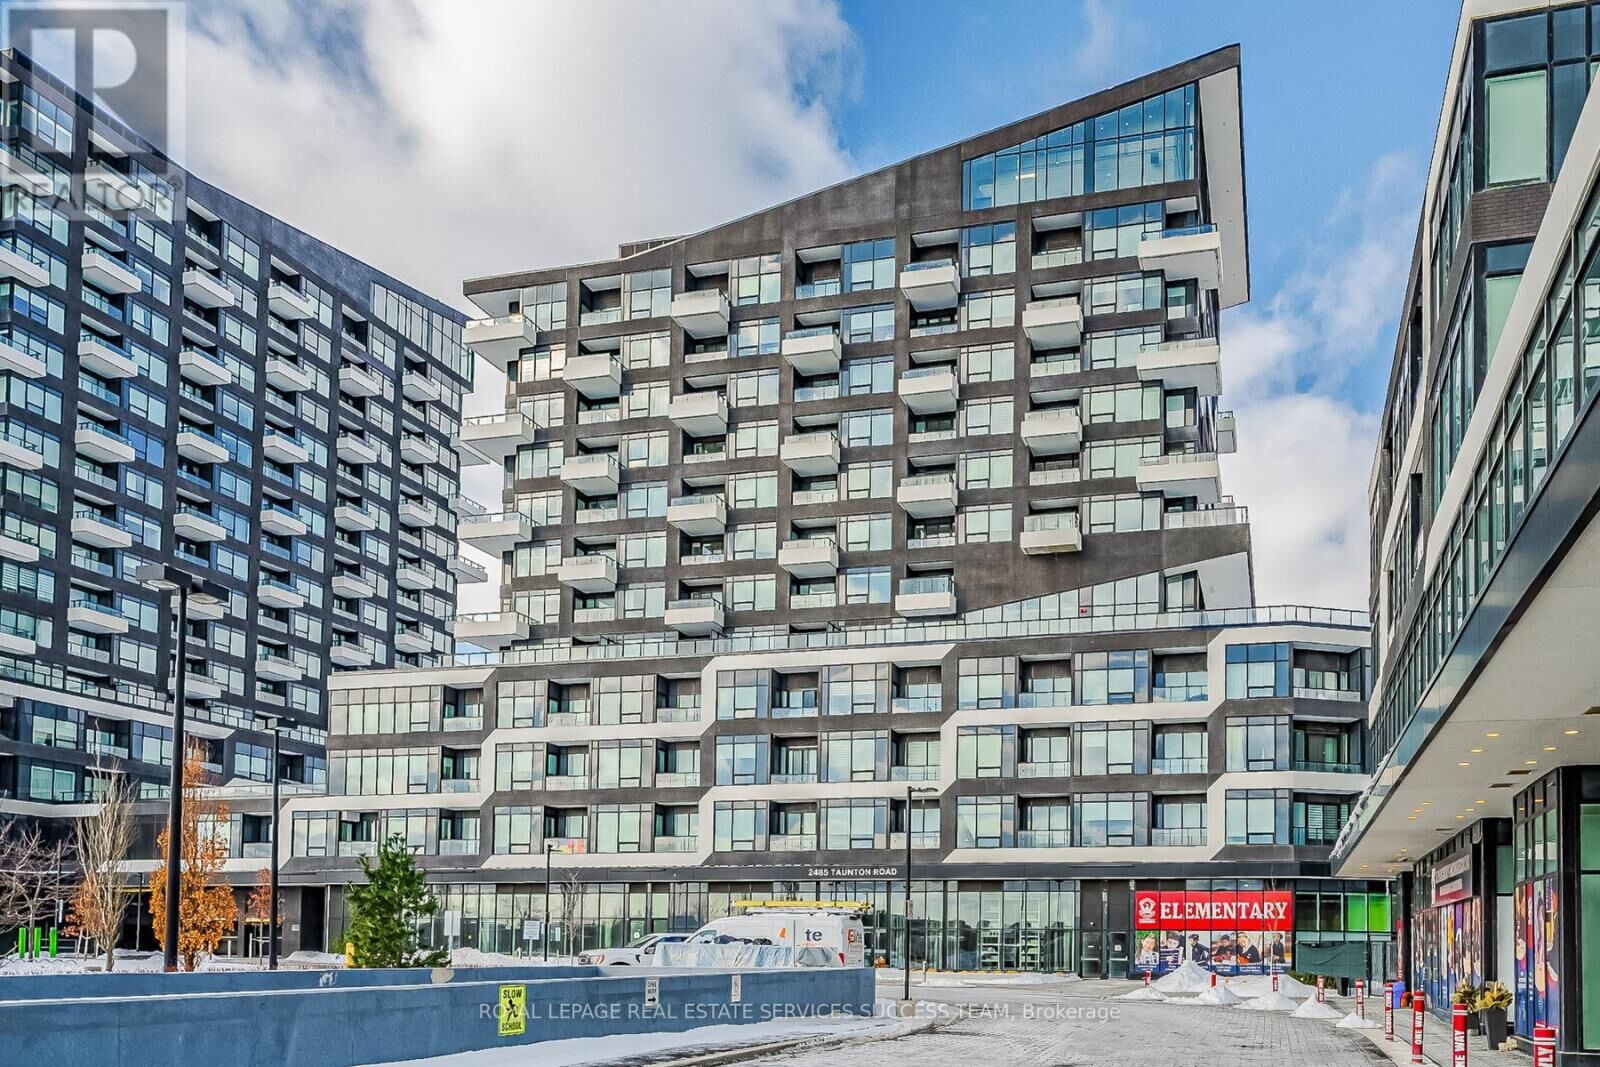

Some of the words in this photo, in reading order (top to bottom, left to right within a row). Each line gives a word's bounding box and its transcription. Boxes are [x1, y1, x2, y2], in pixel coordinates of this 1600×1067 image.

[808, 868, 829, 876] 2485
[831, 868, 871, 876] TAUNTON
[873, 867, 898, 876] ROAD
[1160, 902, 1288, 920] ELEMENTARY
[502, 989, 523, 999] SLOW
[501, 1022, 522, 1031] SCHOOL
[1415, 1011, 1424, 1028] WAY
[1415, 1029, 1423, 1045] ONE
[1454, 1029, 1466, 1052] WAY
[1454, 1054, 1466, 1067] NE
